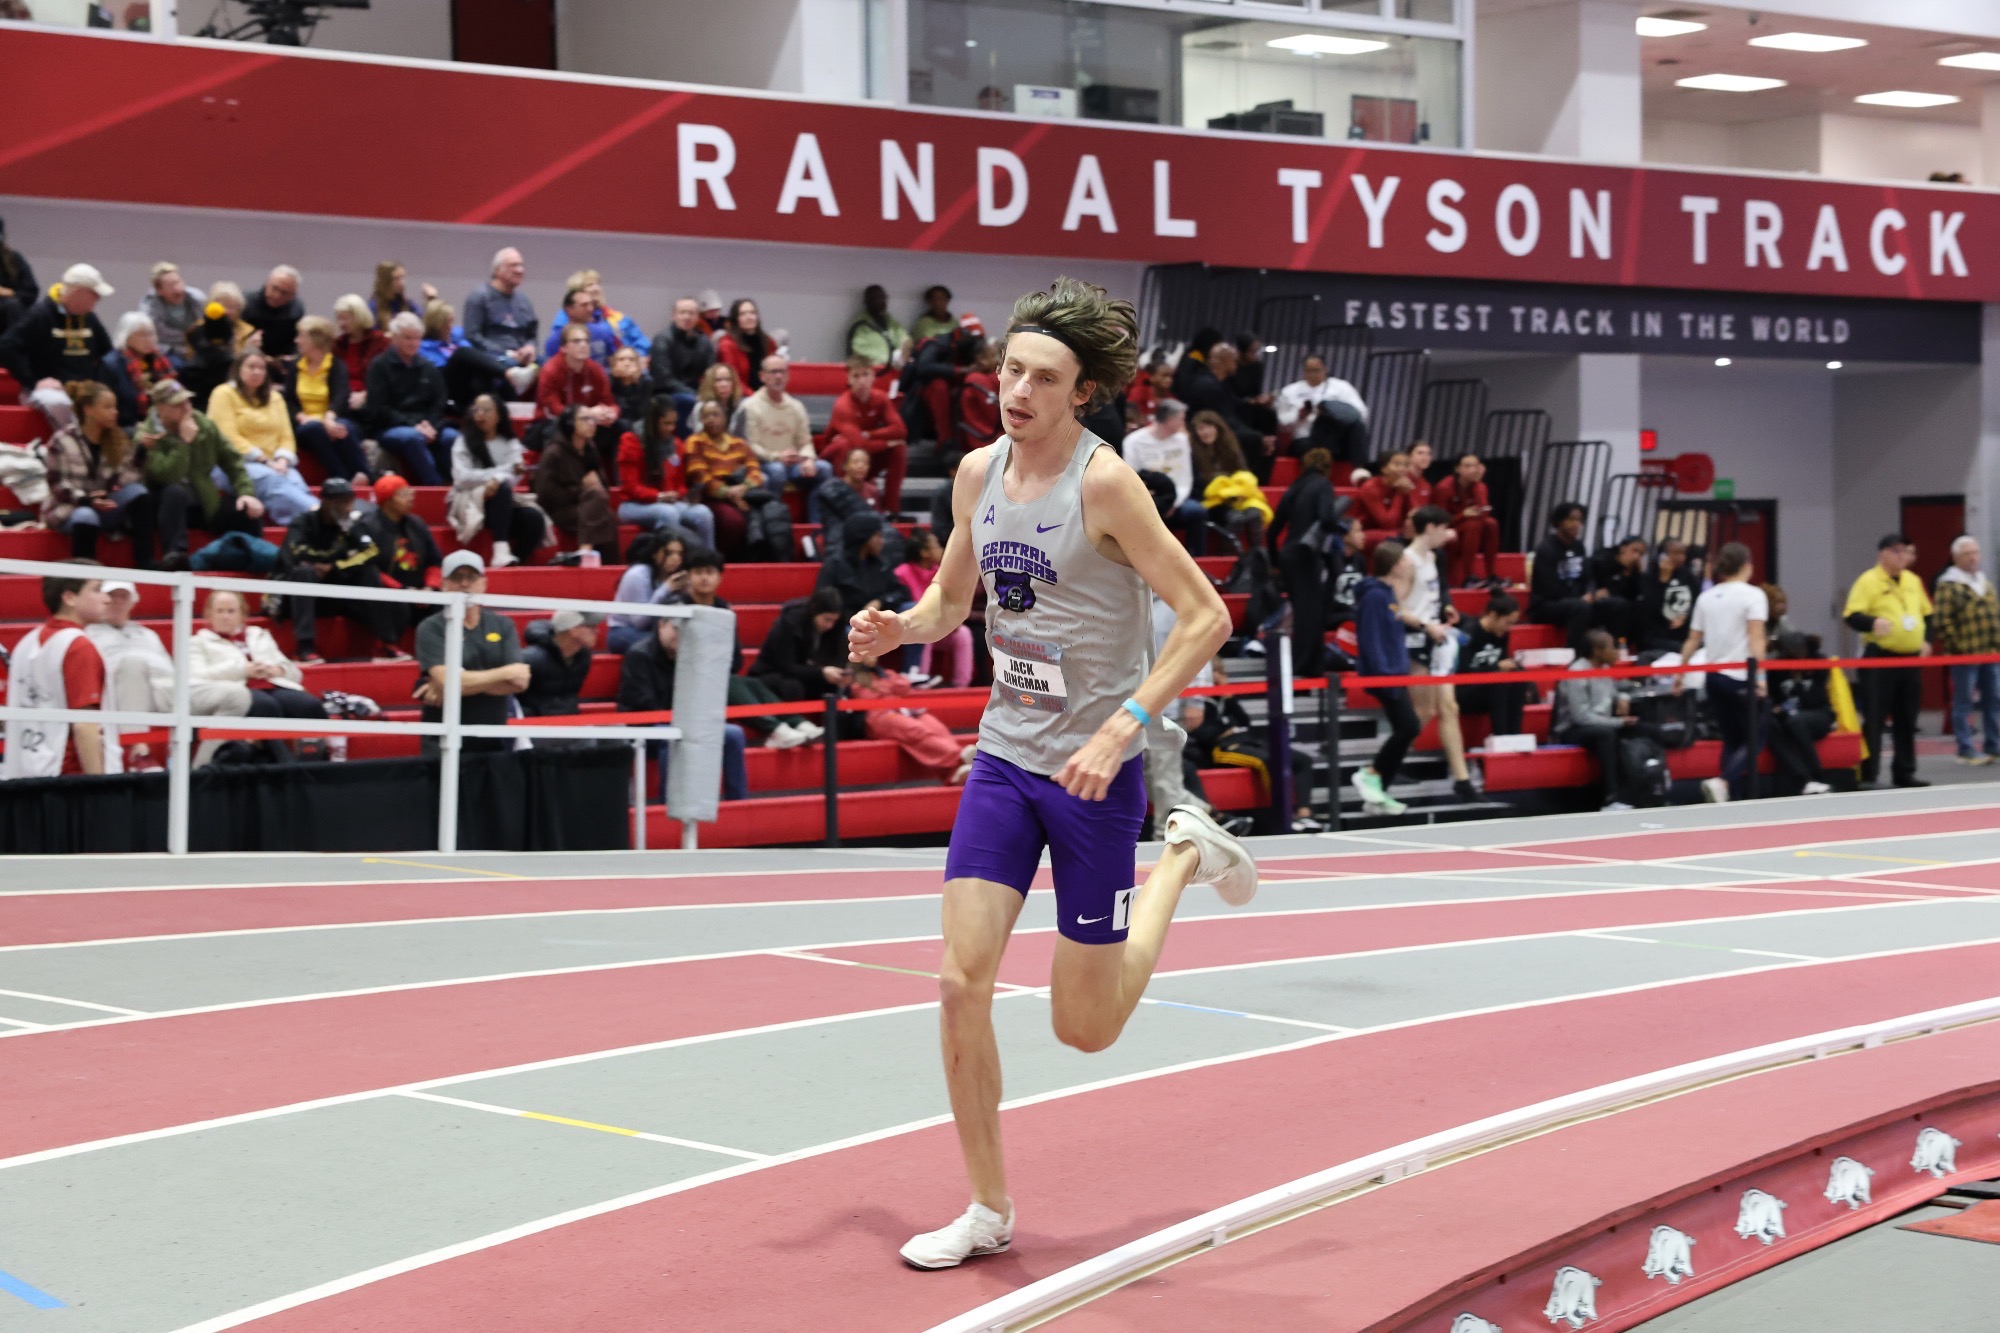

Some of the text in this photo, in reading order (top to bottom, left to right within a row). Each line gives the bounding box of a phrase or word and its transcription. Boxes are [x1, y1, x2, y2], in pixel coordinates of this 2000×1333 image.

[677, 123, 1968, 277] RANDAL TYSON TRACK
[1345, 300, 1850, 344] FASTEST TRACK IN THE WORLD
[982, 541, 1052, 568] CENTRAL
[980, 555, 1058, 584] ARKANSAS
[1003, 669, 1050, 693] DINGMAN
[1010, 658, 1035, 676] JACK
